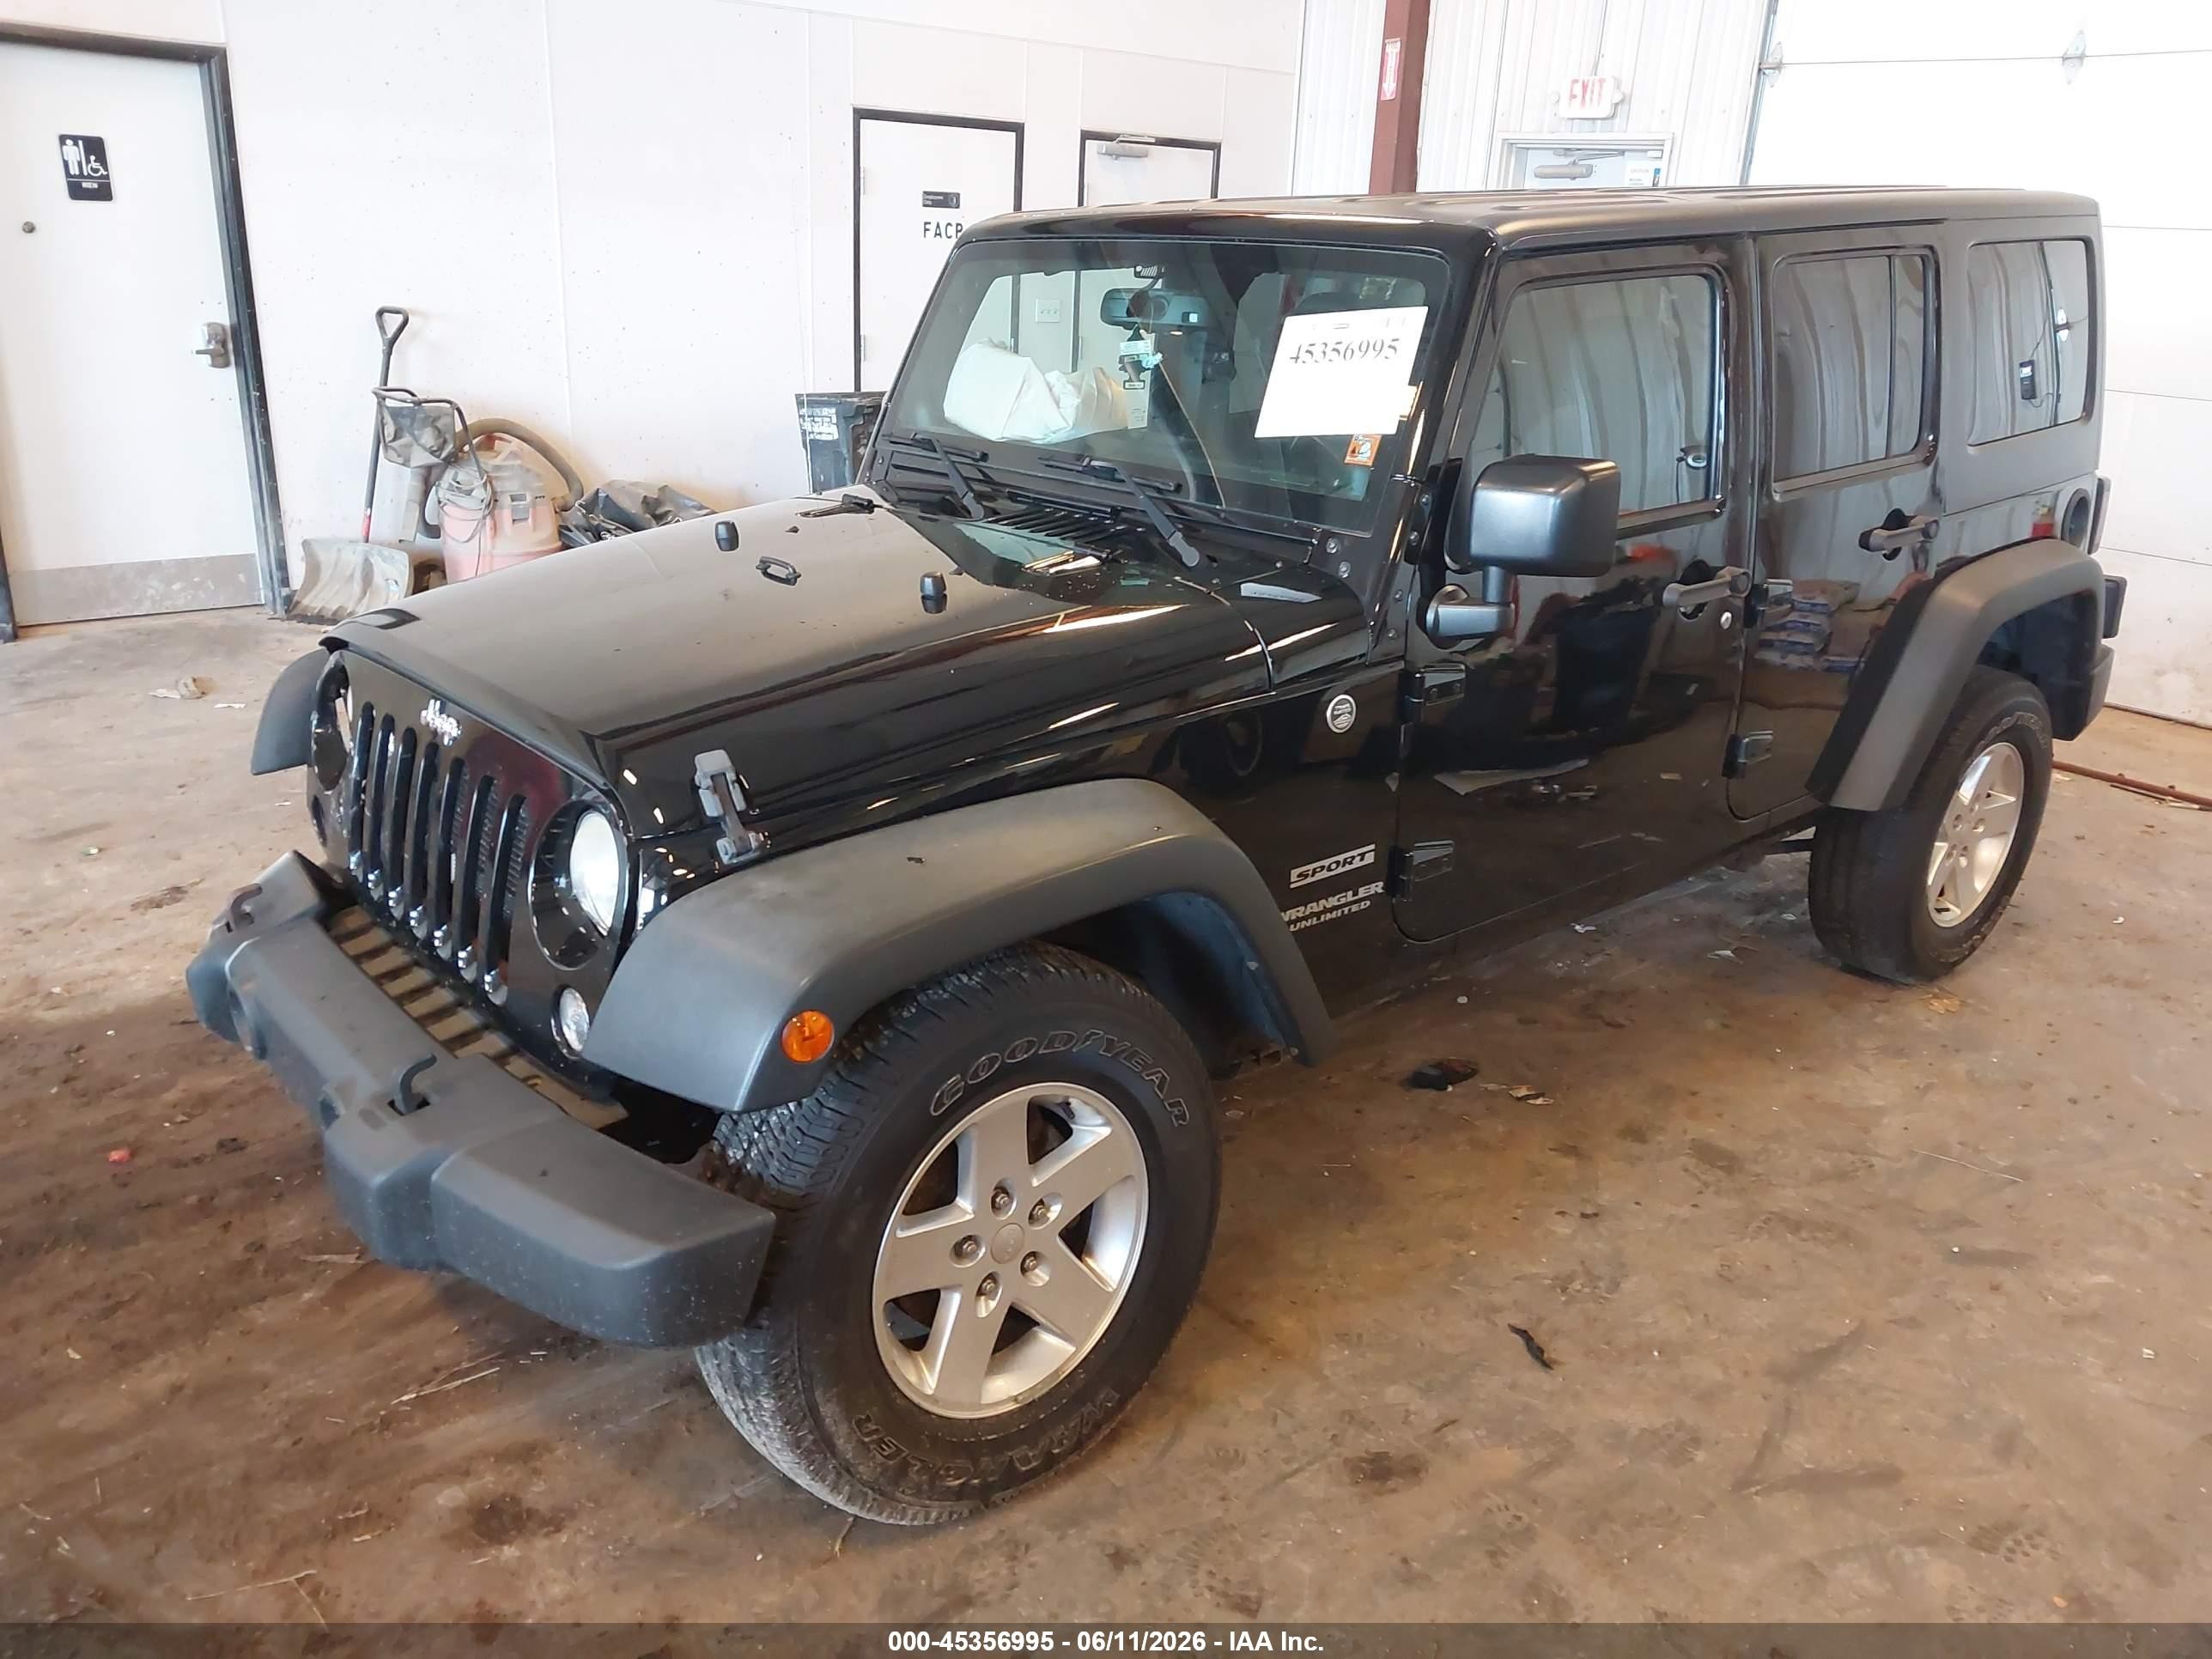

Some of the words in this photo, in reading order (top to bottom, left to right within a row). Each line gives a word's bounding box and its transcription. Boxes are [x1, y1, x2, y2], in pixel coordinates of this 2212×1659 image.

[1568, 78, 1607, 108] EXIT
[1290, 338, 1401, 364] 45356995
[1291, 850, 1372, 883] SPORT
[1289, 900, 1371, 932] UNLIMITED
[930, 1030, 1190, 1127] GOODYEAR
